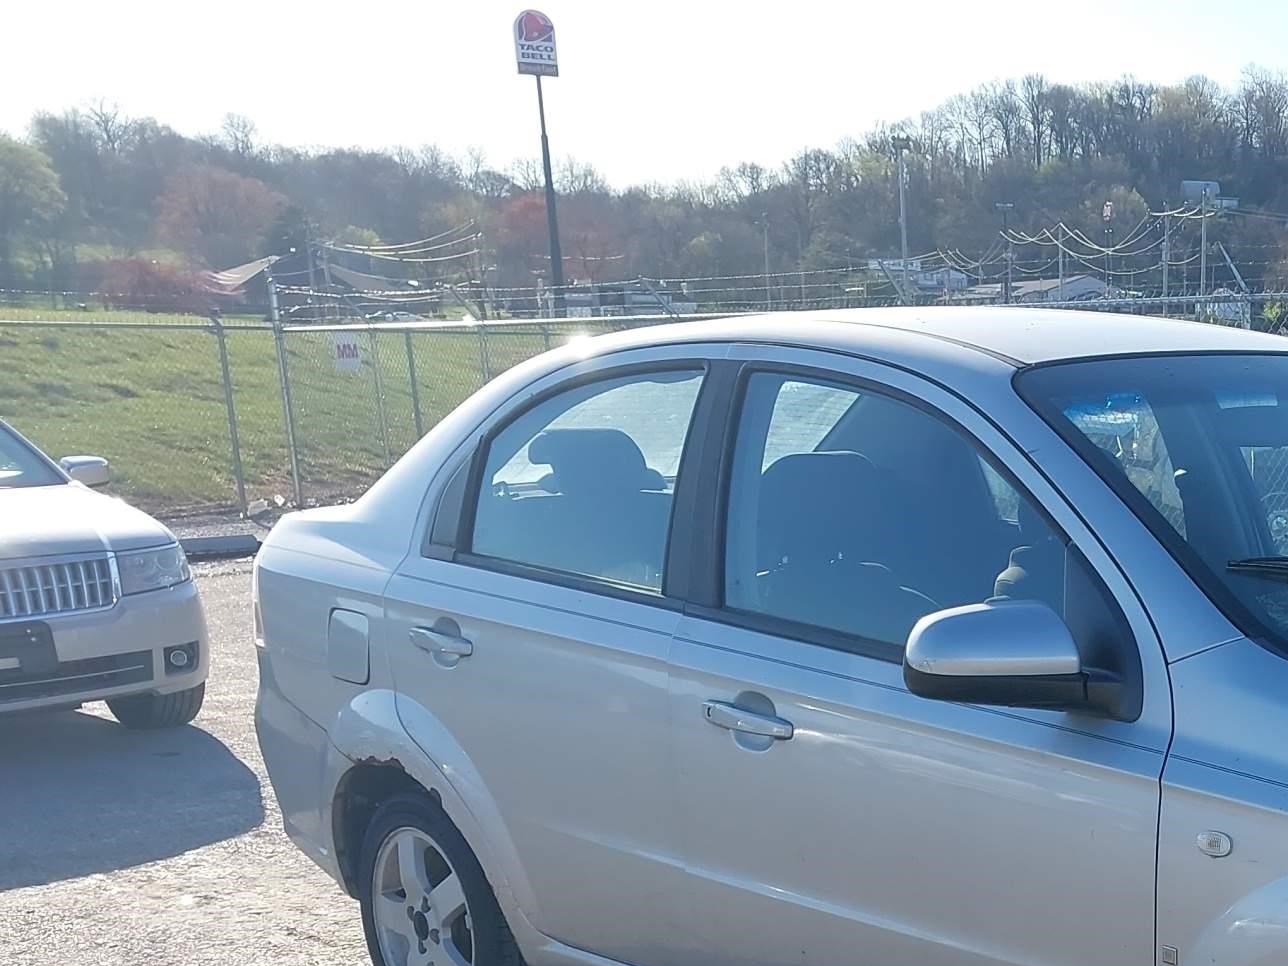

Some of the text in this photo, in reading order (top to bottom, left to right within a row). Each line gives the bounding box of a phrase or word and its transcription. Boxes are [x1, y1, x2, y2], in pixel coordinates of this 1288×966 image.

[519, 43, 554, 53] TACO
[521, 52, 555, 61] BELL
[337, 343, 358, 359] MM
